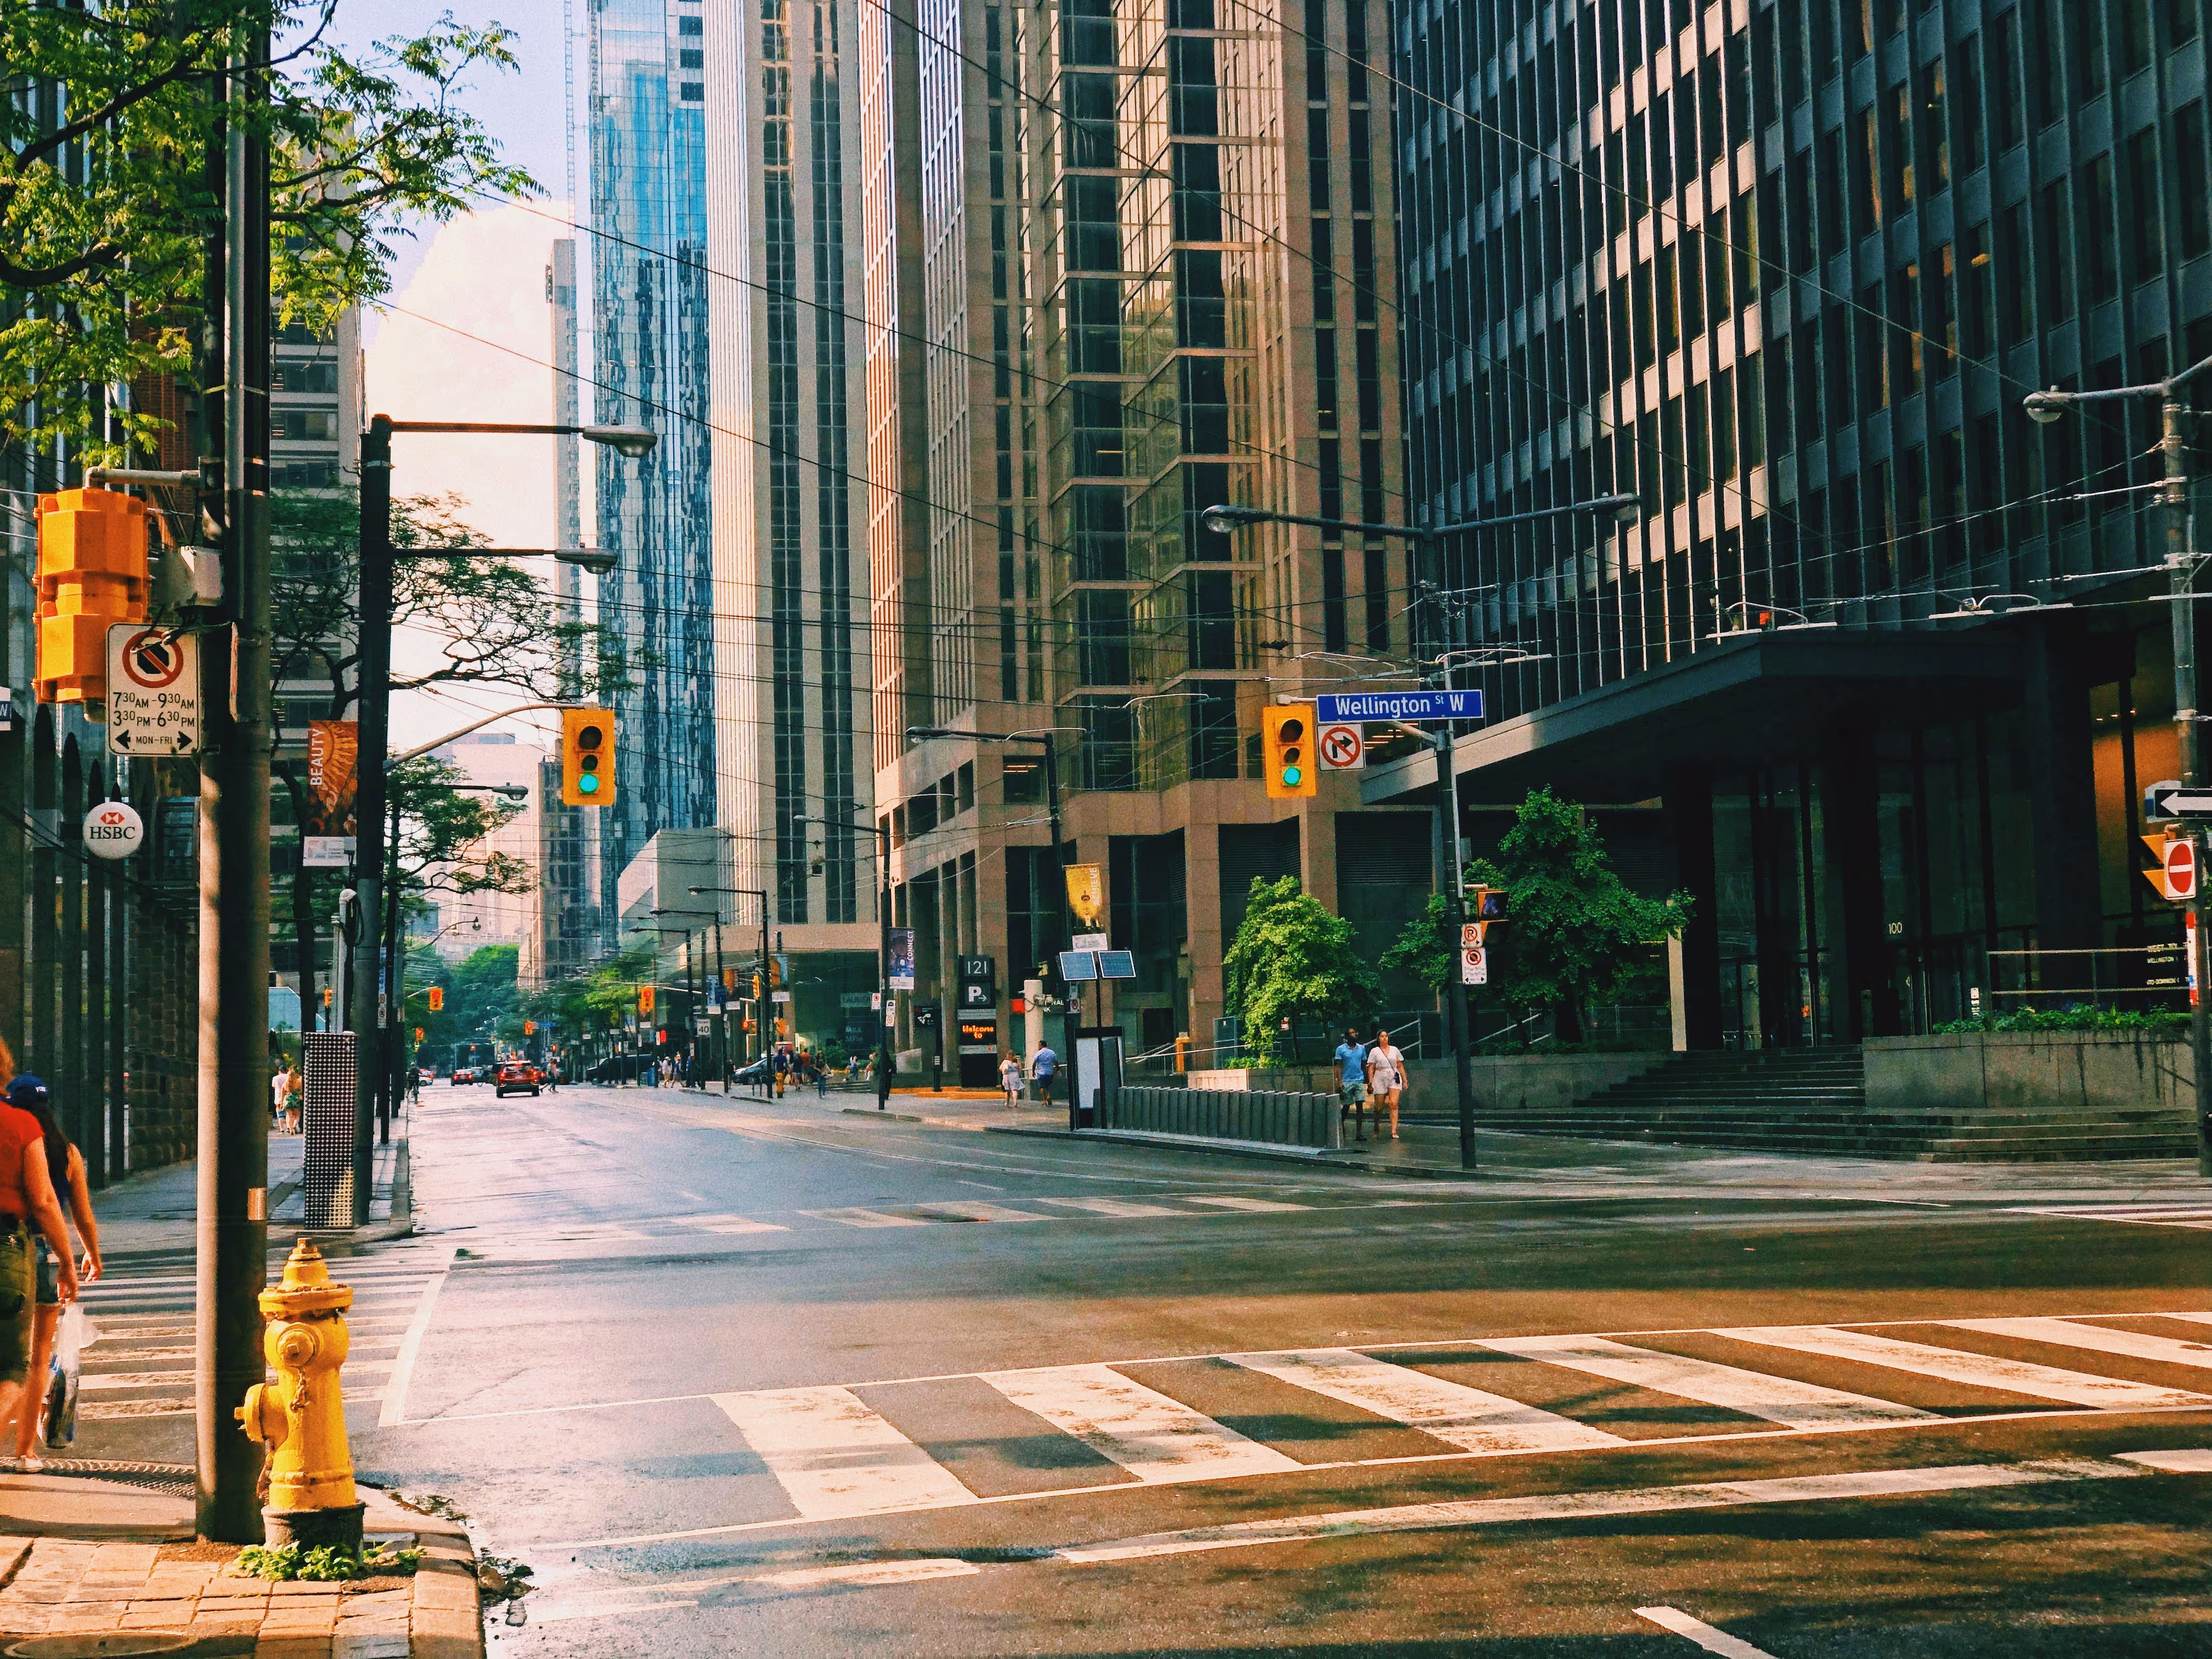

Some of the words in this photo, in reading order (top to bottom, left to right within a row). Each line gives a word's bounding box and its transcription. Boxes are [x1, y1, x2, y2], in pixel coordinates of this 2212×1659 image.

[1335, 696, 1430, 718] Wellington
[1435, 695, 1444, 705] St
[1449, 694, 1464, 712] W
[136, 736, 172, 744] MON-FRI
[310, 728, 325, 786] BEAUTY
[89, 827, 135, 839] HSBC
[1888, 922, 1903, 934] 100
[968, 961, 987, 974] 121
[968, 986, 982, 1002] P
[962, 1025, 994, 1033] Welcome
